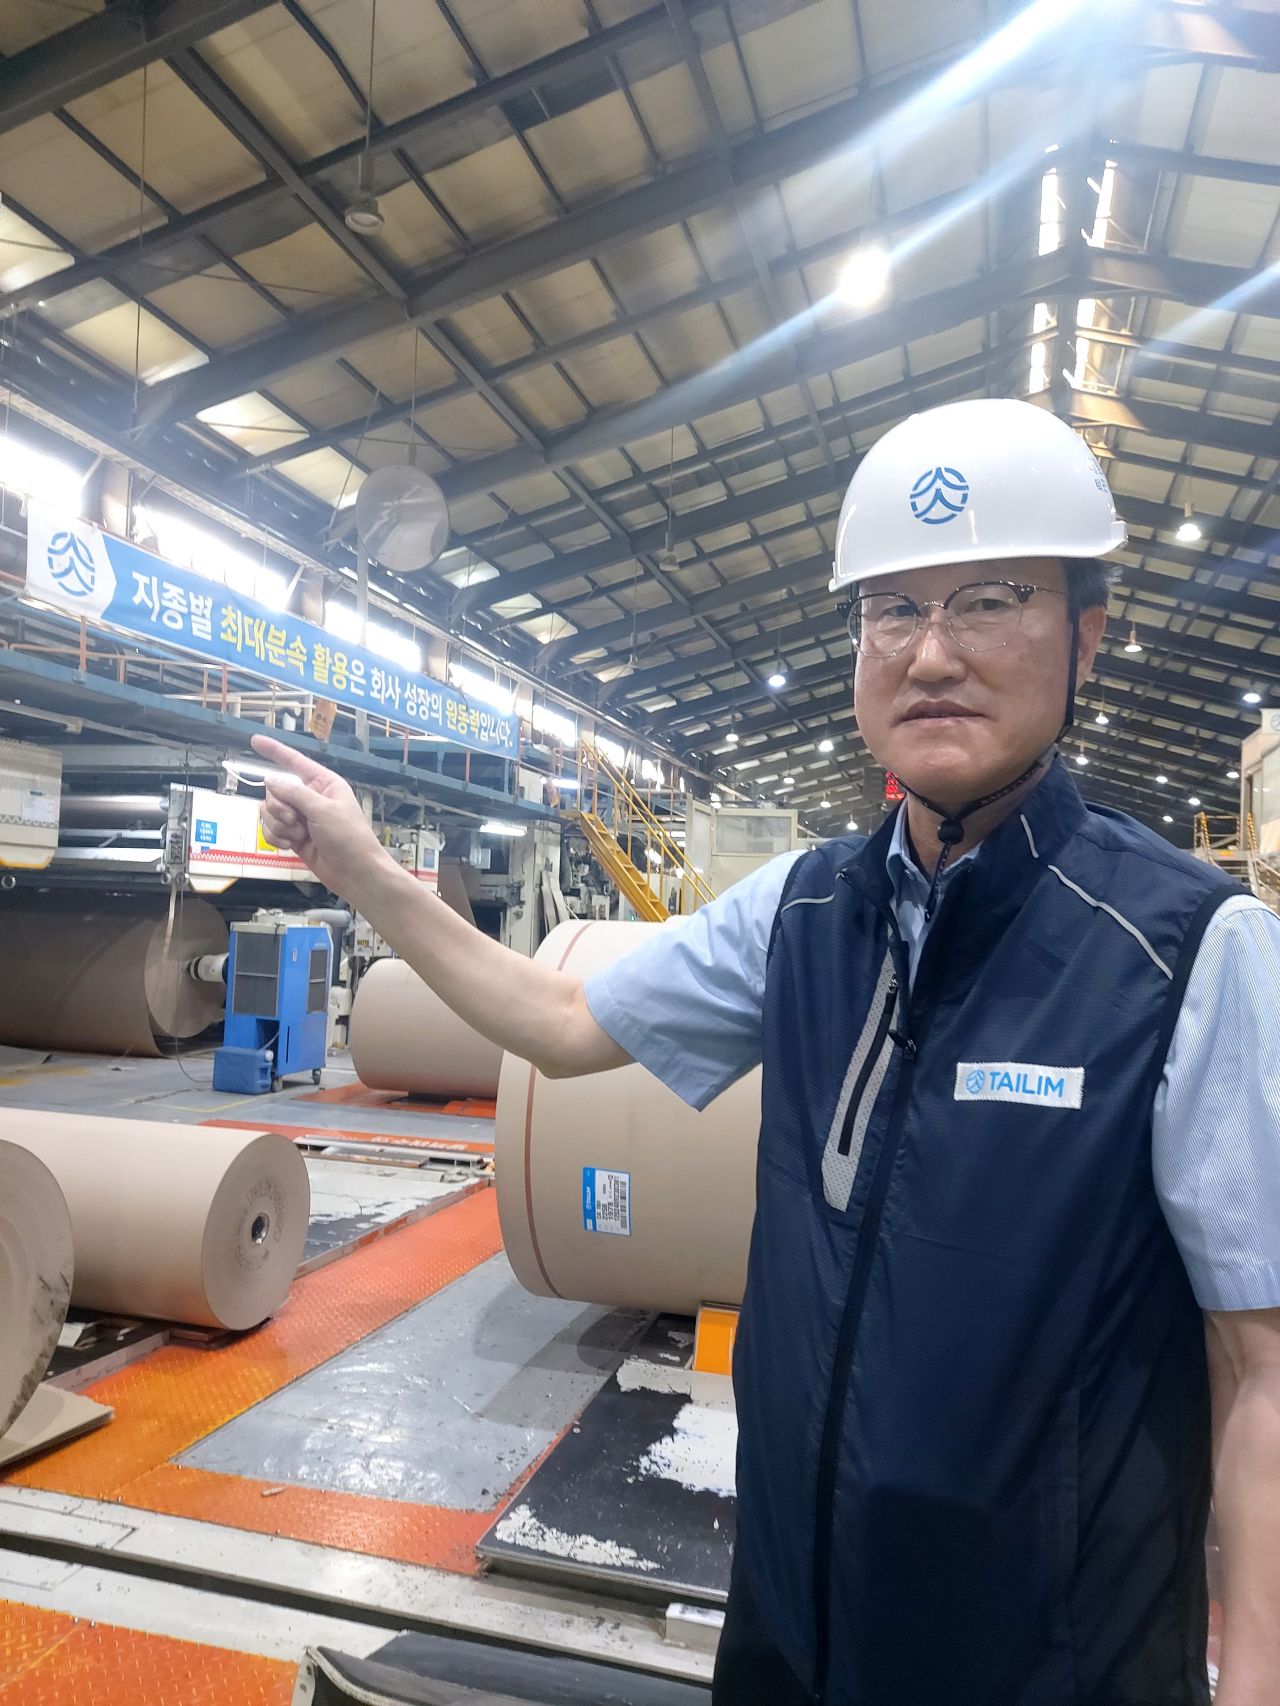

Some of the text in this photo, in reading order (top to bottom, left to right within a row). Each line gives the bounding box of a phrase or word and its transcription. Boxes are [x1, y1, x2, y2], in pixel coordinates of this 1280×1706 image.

[132, 570, 513, 748] 지종별 최대분속 활용은 회사 성장의 원동력입니다.
[989, 1071, 1065, 1098] TAILIM
